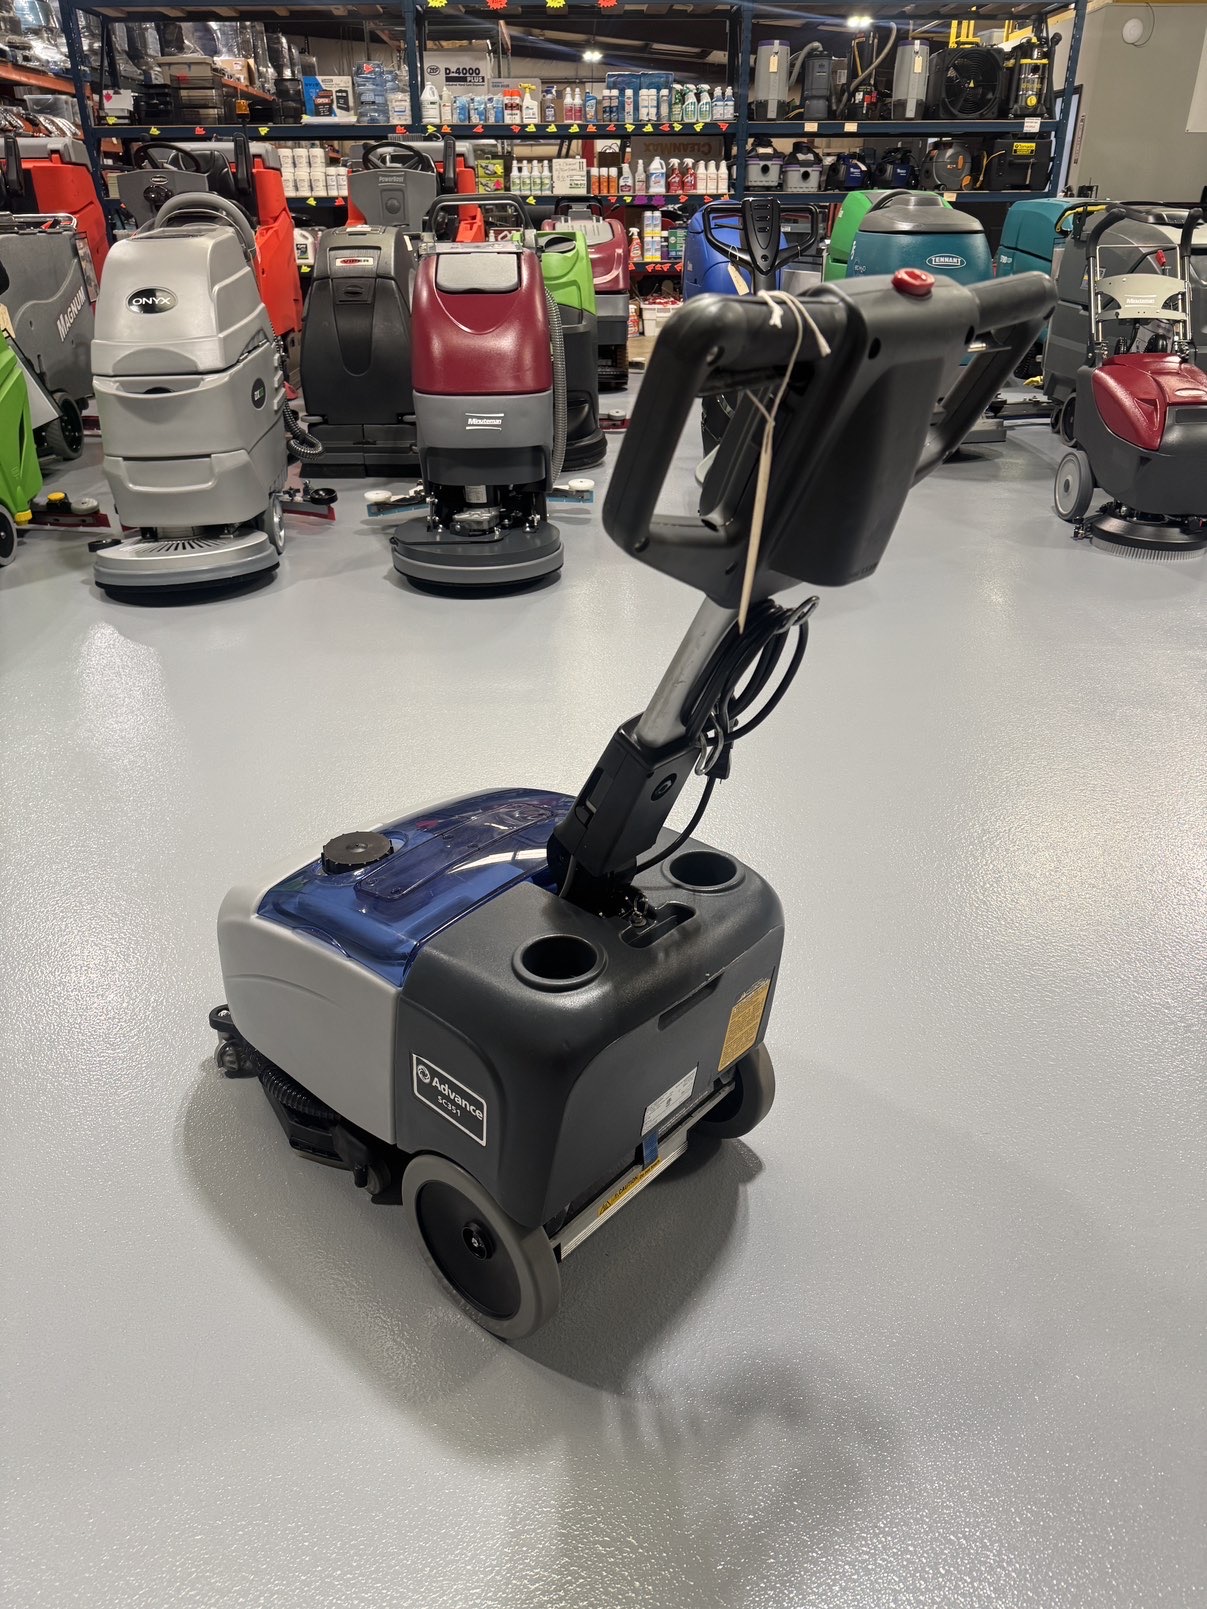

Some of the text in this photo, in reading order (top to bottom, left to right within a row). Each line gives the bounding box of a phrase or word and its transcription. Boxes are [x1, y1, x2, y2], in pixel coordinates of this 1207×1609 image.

[444, 67, 481, 76] D-4000
[932, 257, 961, 265] TENNANT
[132, 297, 171, 305] ONYX
[56, 286, 86, 342] MAGNUM
[432, 1077, 483, 1121] Advance
[437, 1095, 461, 1117] SC351
